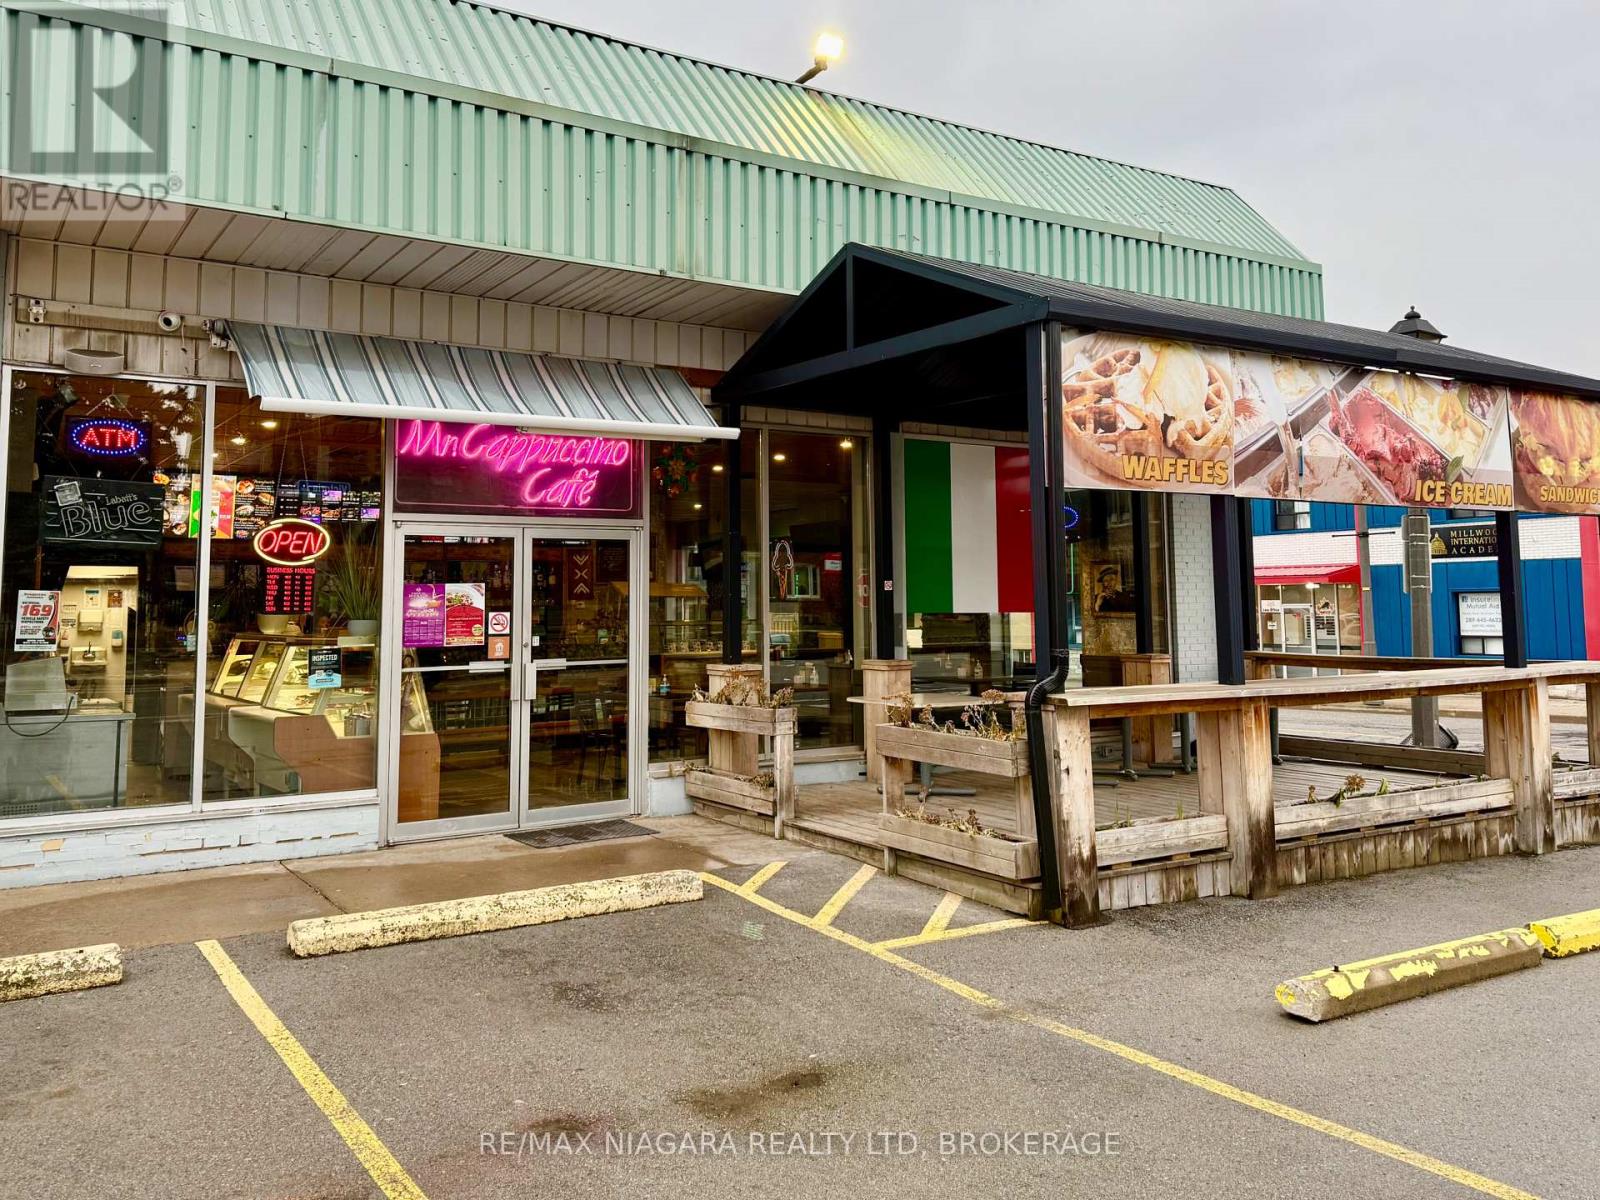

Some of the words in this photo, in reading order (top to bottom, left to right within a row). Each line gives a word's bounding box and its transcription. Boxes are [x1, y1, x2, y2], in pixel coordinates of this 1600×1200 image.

[81, 427, 136, 447] ATM
[462, 422, 630, 473] Cappuccino
[1121, 454, 1229, 486] WAFFLES
[522, 467, 600, 507] Café
[1414, 479, 1446, 503] ICE
[1450, 482, 1513, 507] CREAM
[60, 501, 153, 538] Blue
[259, 530, 323, 554] OPEN
[1451, 545, 1498, 555] ACADE
[312, 654, 338, 662] INSPECTED
